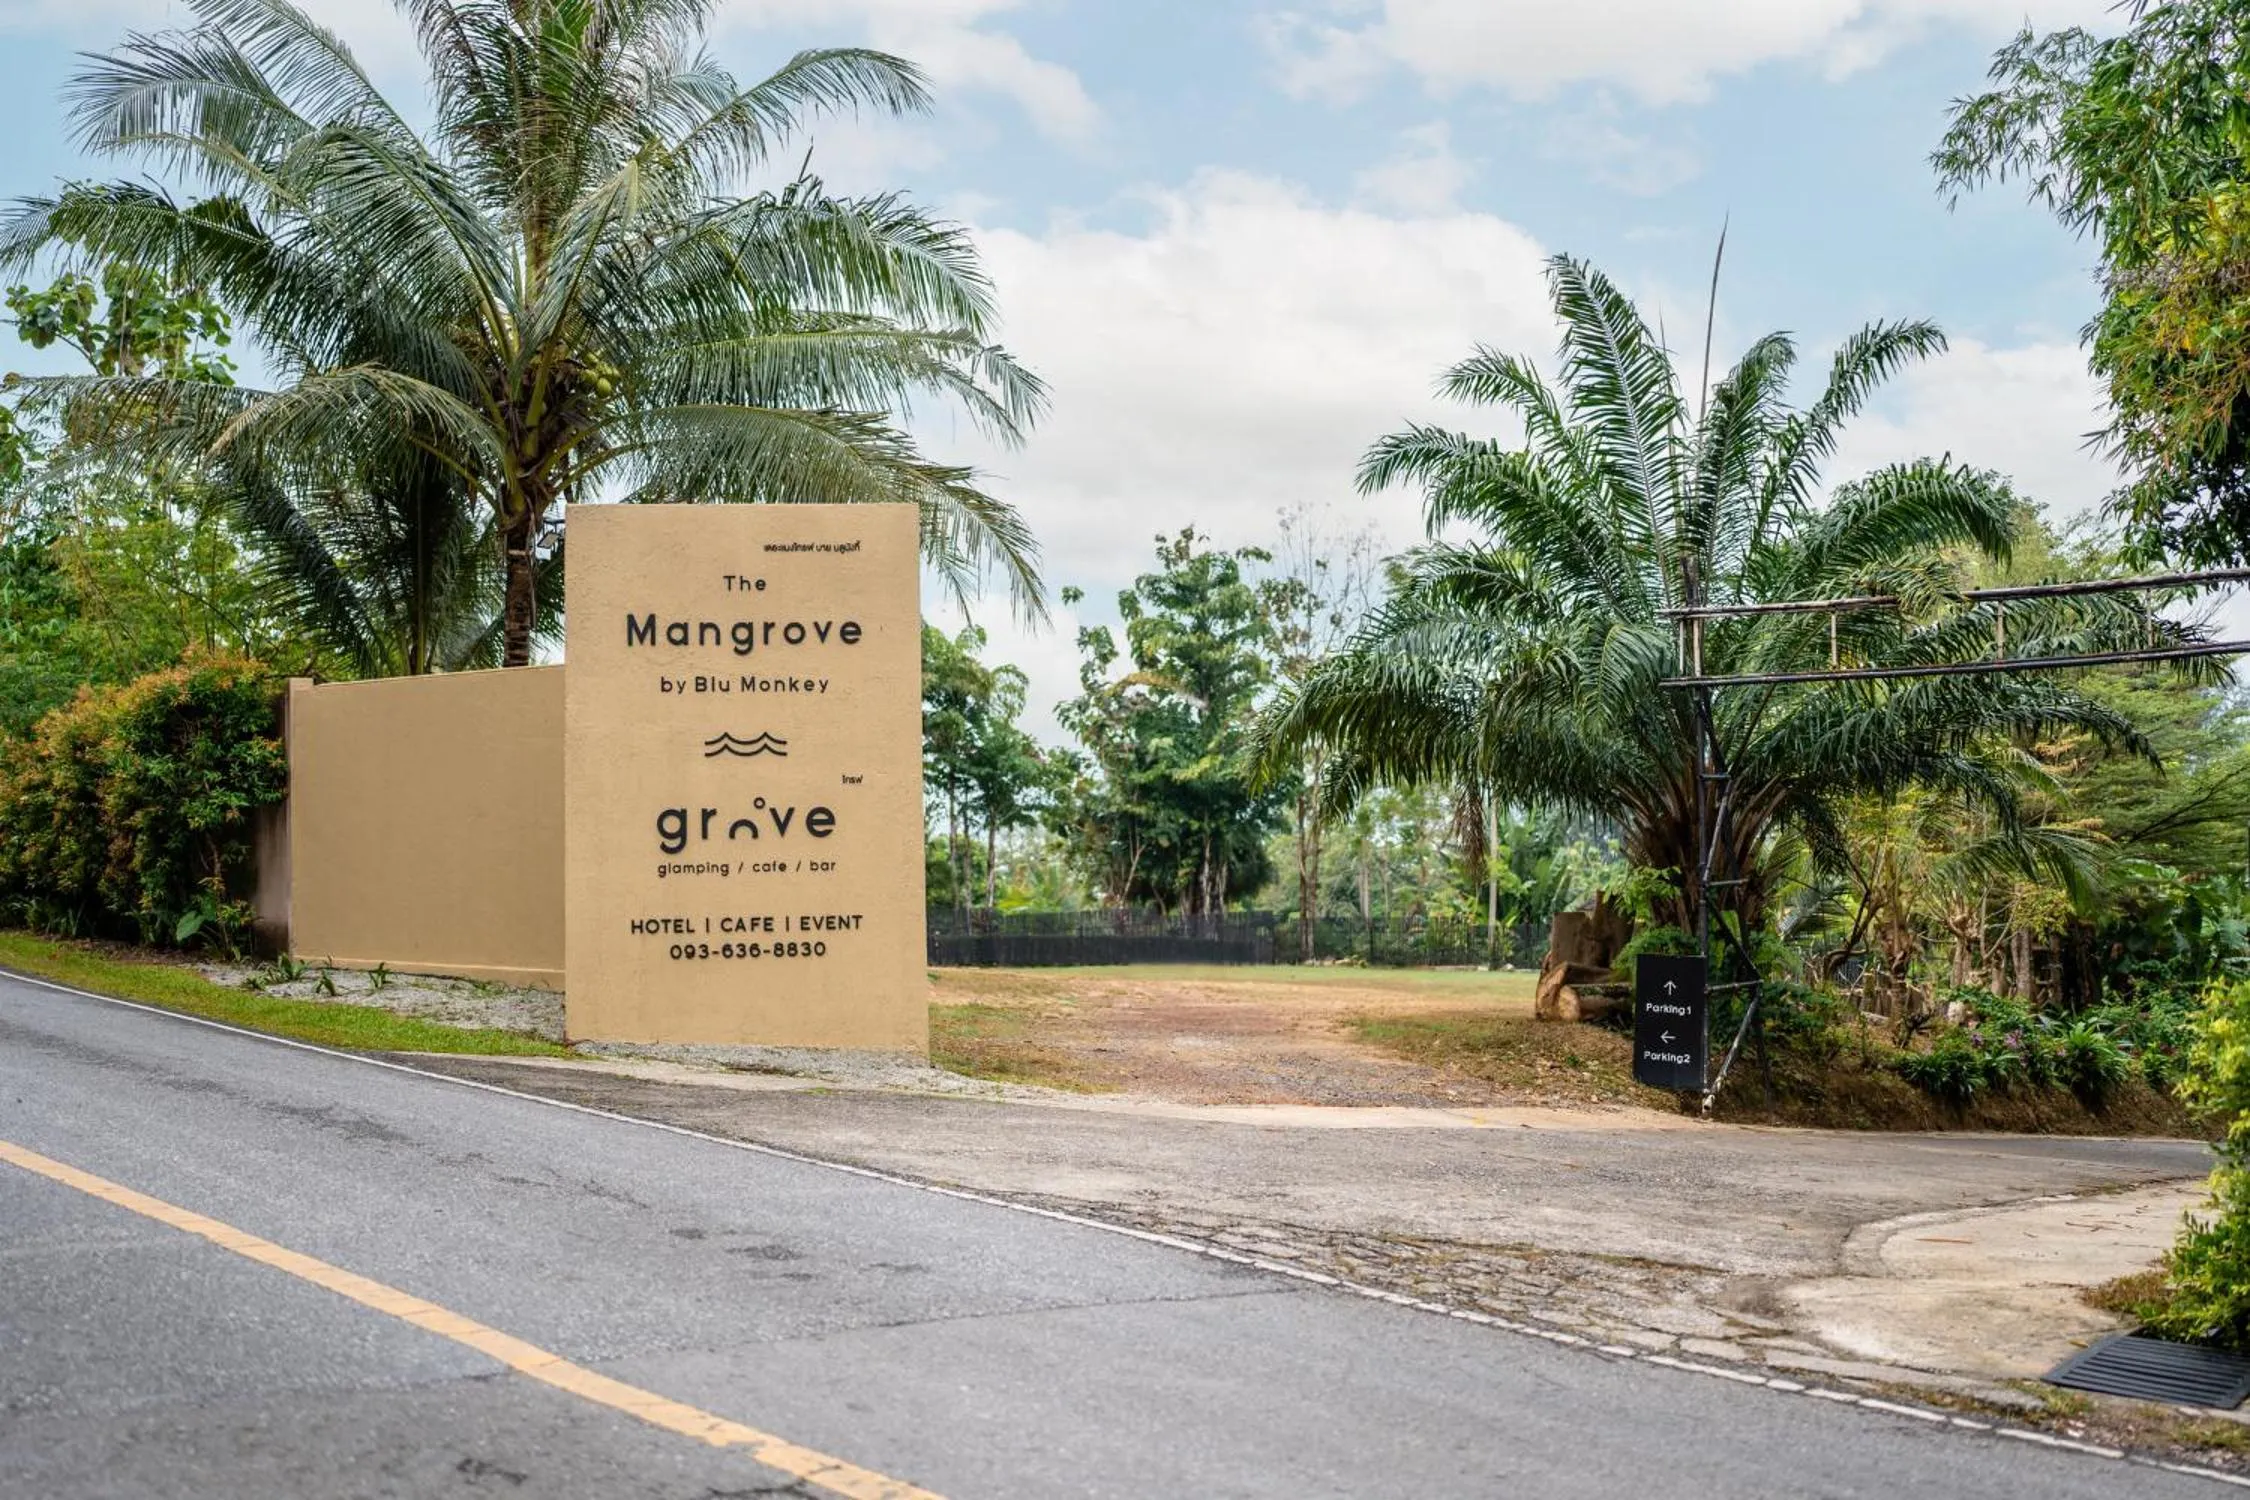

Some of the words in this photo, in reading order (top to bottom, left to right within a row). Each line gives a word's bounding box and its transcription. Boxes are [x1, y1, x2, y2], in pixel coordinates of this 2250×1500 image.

[722, 575, 767, 592] The
[626, 613, 863, 657] Mangrove
[660, 676, 687, 695] by
[694, 675, 731, 693] Blu
[740, 675, 829, 694] Monkey
[657, 861, 730, 878] glamping
[752, 860, 788, 874] cafe
[809, 860, 837, 873] bar
[630, 918, 696, 936] HOTEL
[720, 916, 775, 933] CAFE
[799, 914, 863, 931] EVENT
[669, 941, 827, 961] 093-636-8830
